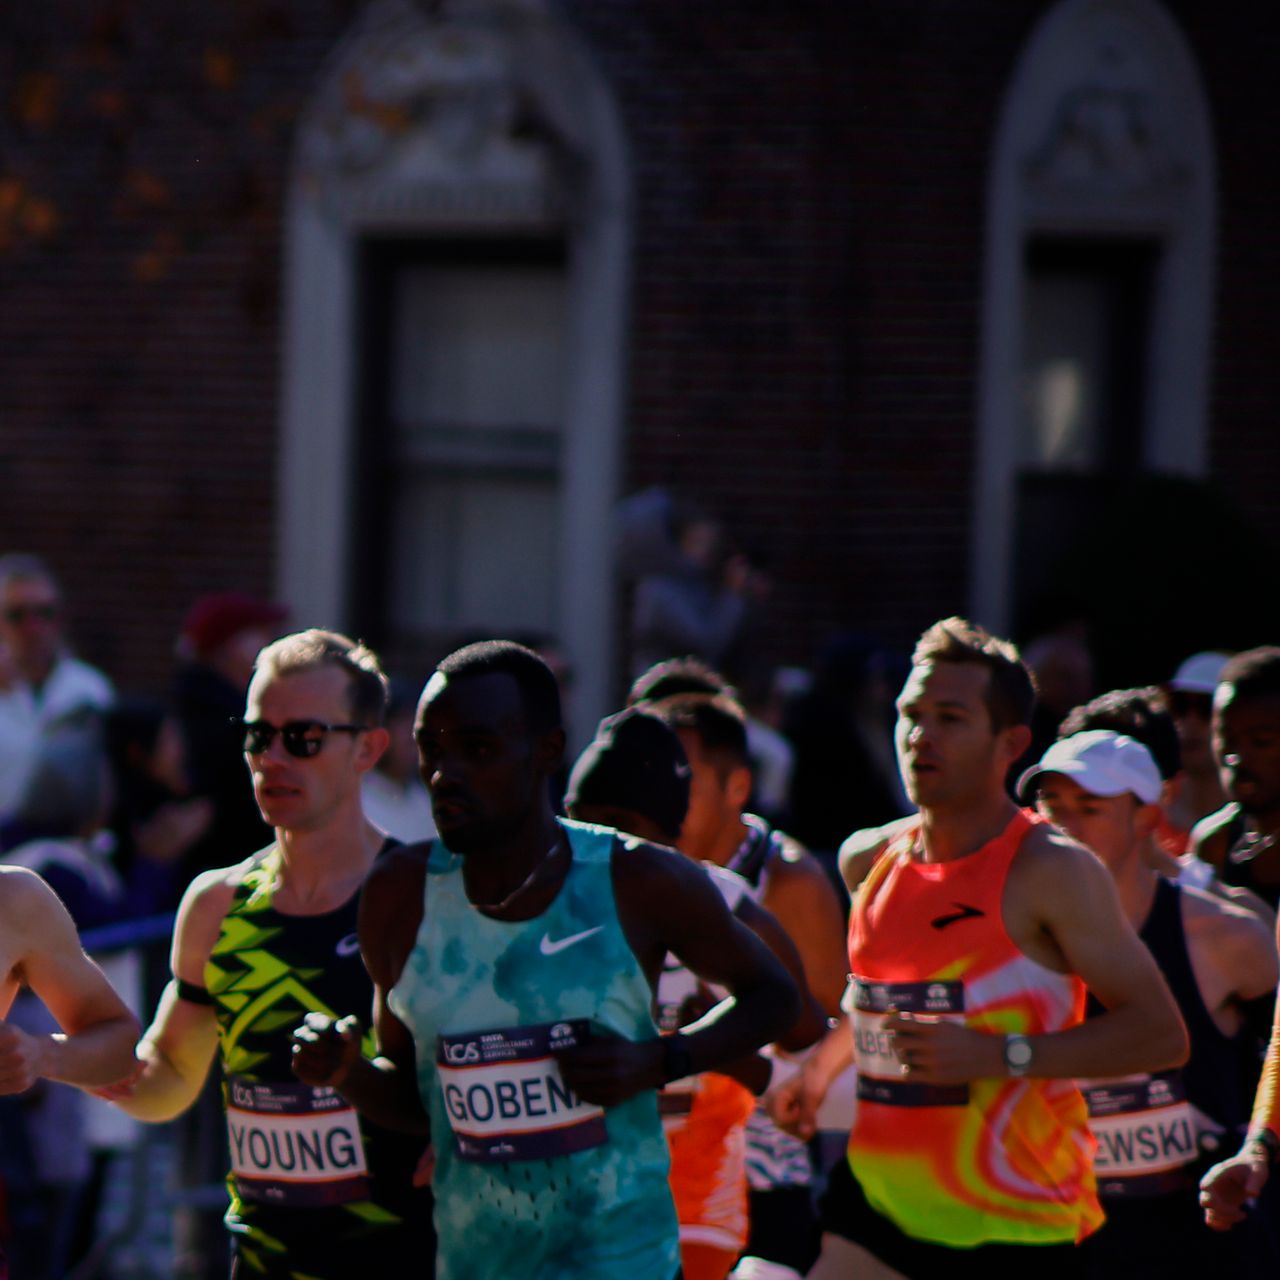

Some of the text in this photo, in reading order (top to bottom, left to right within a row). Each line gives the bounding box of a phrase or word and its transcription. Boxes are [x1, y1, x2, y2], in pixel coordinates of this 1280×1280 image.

[443, 1039, 480, 1063] tcs
[549, 1037, 577, 1050] TATA
[445, 1075, 582, 1122] GOBEN
[230, 1121, 358, 1171] YOUNG
